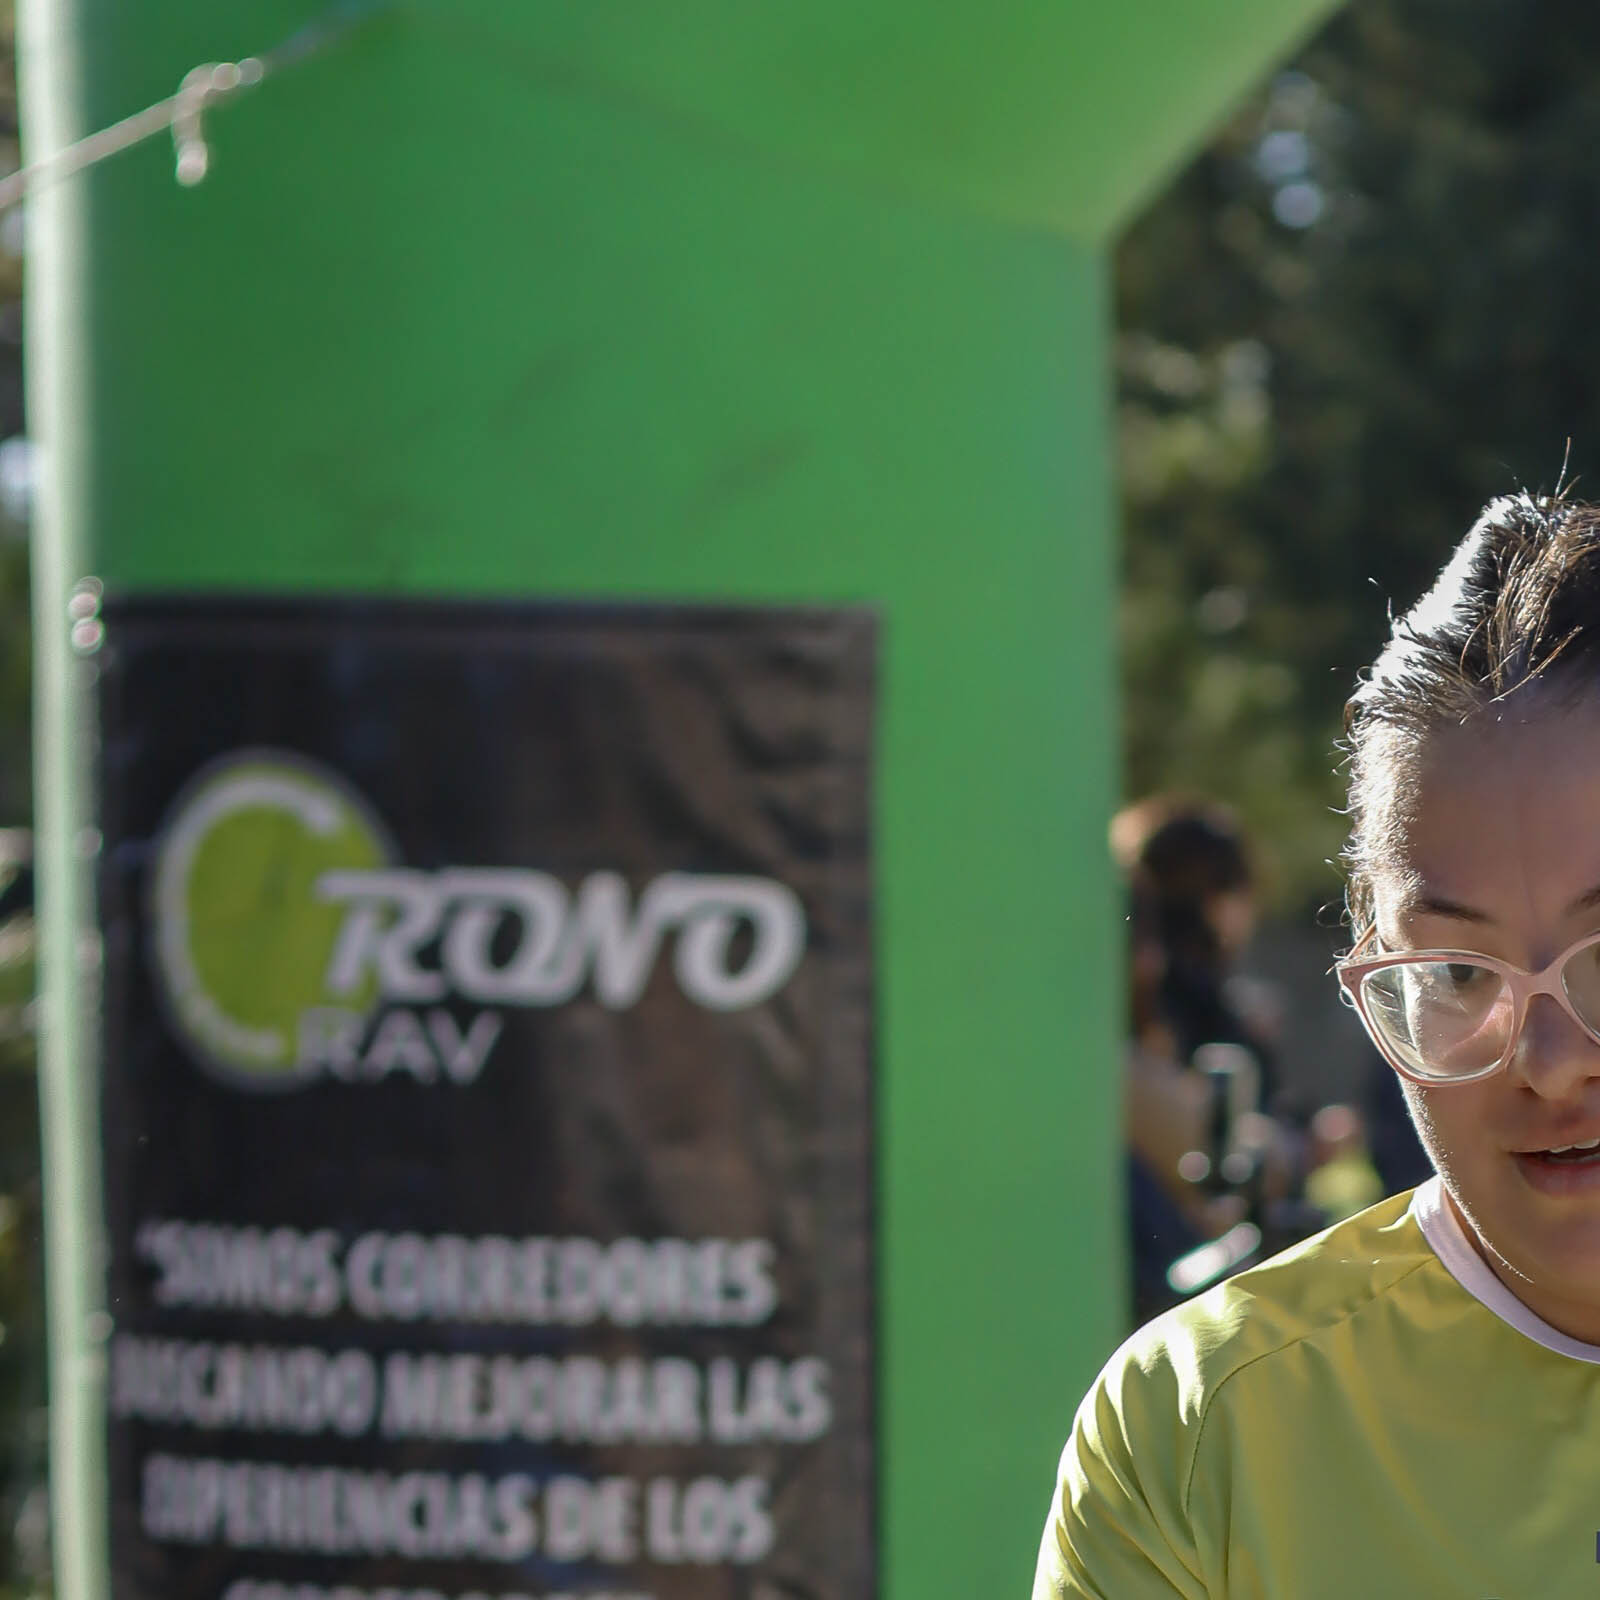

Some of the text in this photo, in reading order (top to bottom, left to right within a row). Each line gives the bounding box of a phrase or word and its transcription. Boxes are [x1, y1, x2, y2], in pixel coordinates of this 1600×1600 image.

[707, 1357, 832, 1444] LAS
[542, 1476, 638, 1563] DE
[646, 1475, 776, 1565] LOS
